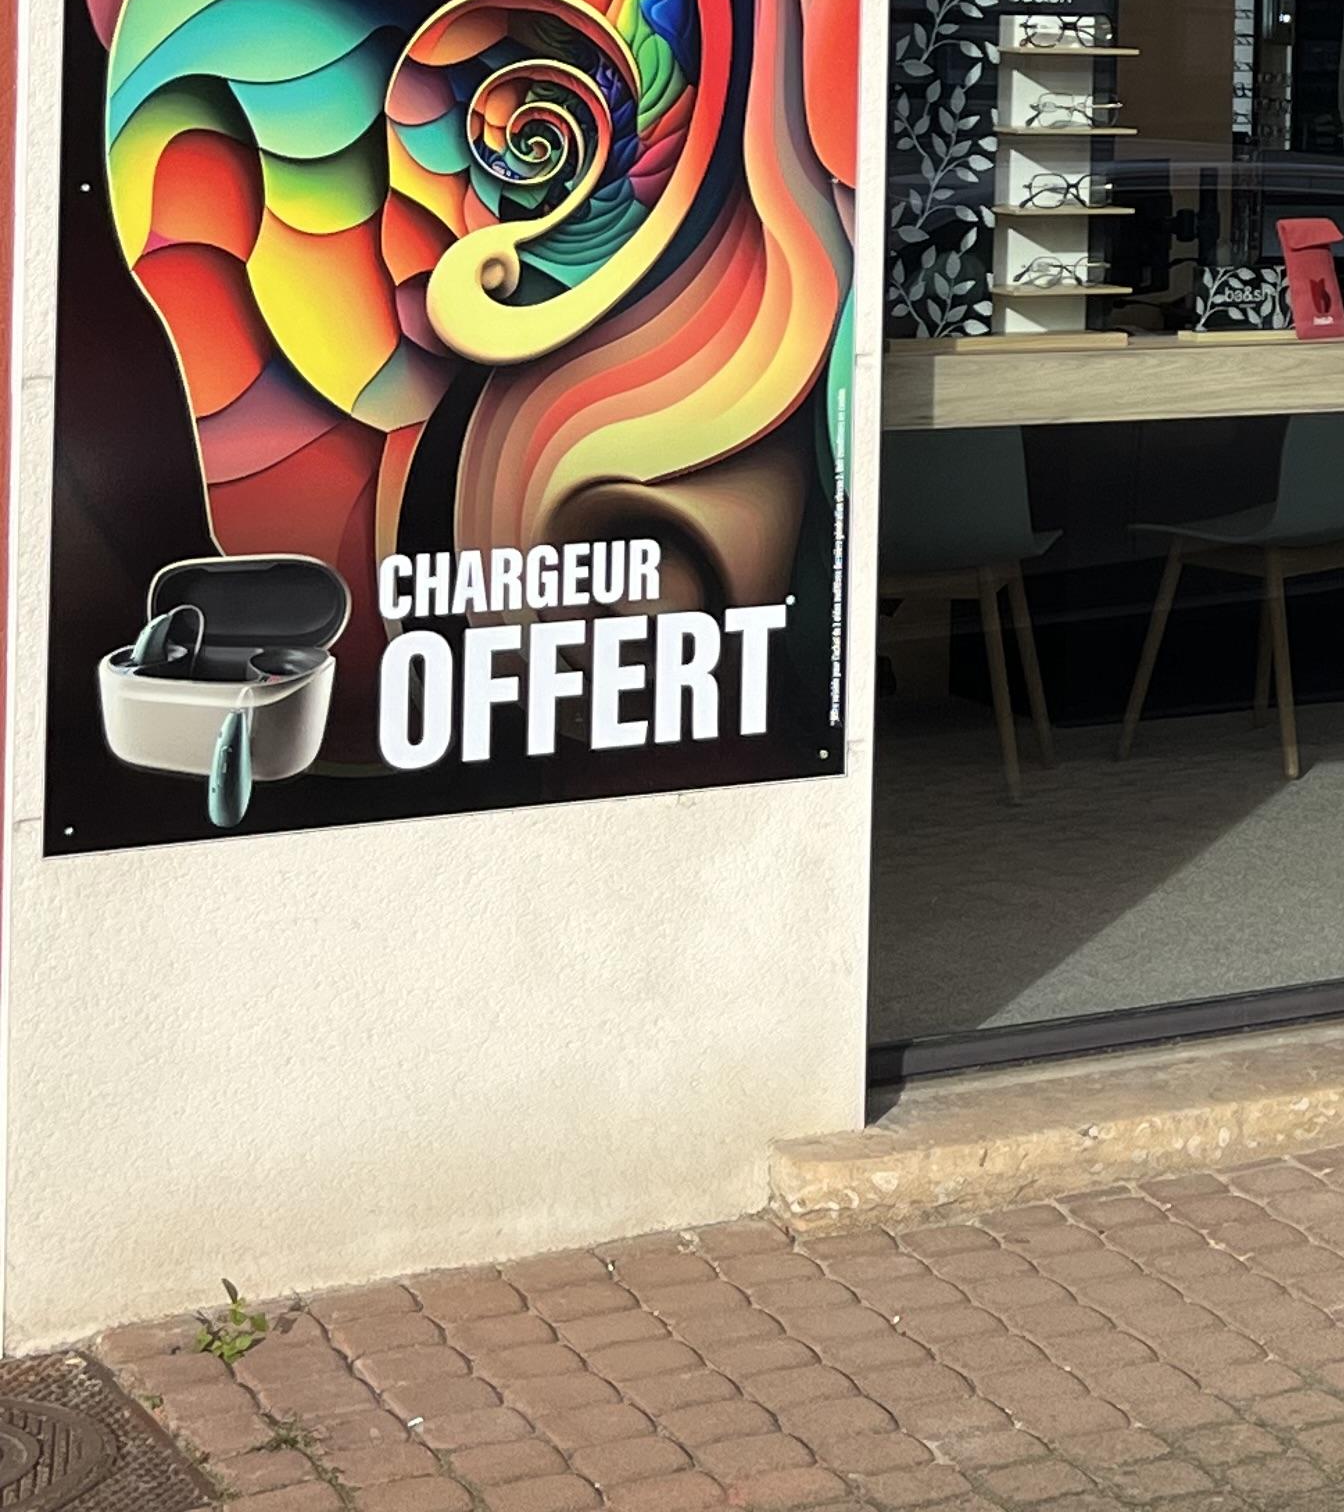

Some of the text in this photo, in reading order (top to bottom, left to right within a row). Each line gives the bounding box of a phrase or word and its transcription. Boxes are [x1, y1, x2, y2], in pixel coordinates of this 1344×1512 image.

[1225, 285, 1275, 302] ba&sh
[378, 538, 661, 619] CHARGEUR
[378, 604, 786, 770] OFFERT
